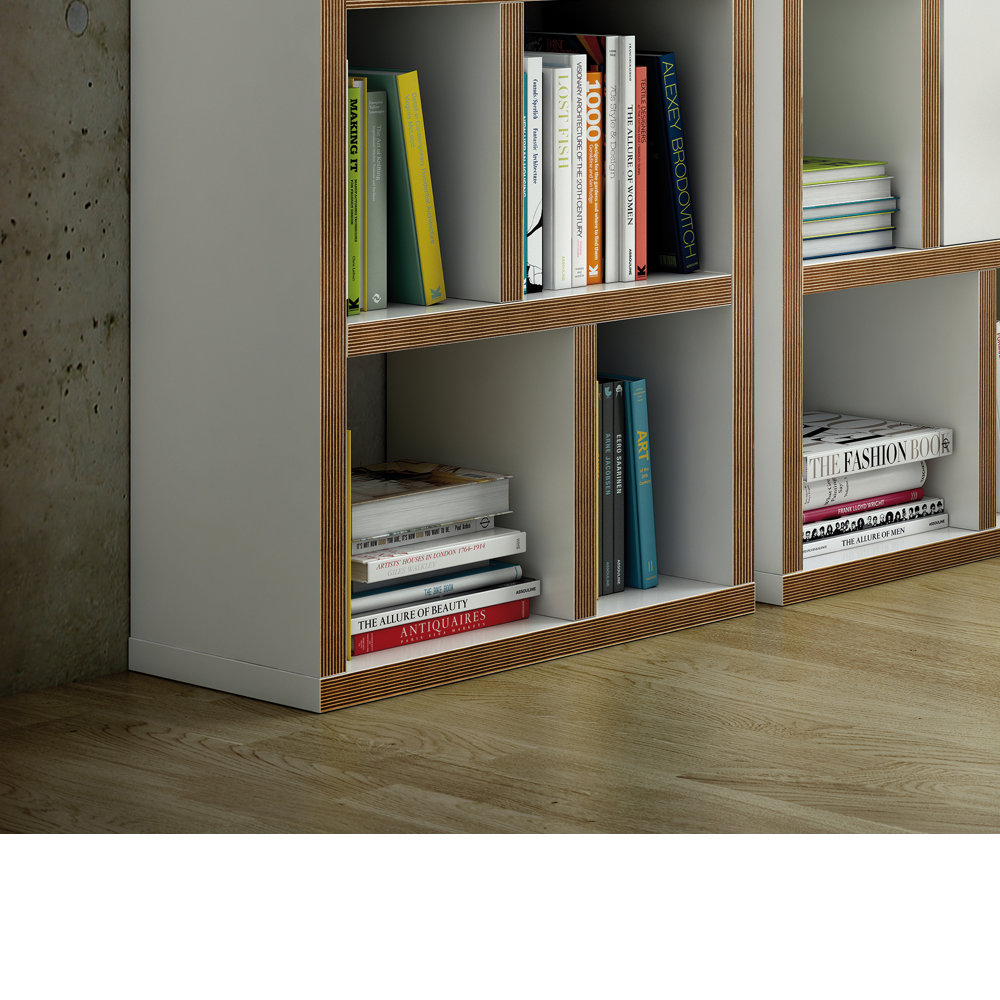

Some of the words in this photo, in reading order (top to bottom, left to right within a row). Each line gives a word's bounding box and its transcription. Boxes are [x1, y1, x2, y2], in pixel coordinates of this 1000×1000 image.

[411, 93, 419, 111] Detail
[558, 75, 569, 124] LOST
[586, 80, 601, 142] 1000
[350, 99, 358, 155] MAKING
[404, 94, 412, 120] Virginia
[408, 122, 416, 148] McLeod
[609, 103, 617, 129] Style
[415, 120, 426, 167] Contemporary
[558, 128, 569, 168] FISH
[610, 131, 617, 139] &
[350, 159, 358, 173] IT
[576, 152, 583, 162] OF
[609, 142, 617, 179] Design
[662, 61, 682, 131] ALEXEY
[672, 137, 697, 258] BRODOVITCH
[421, 168, 432, 205] Residential
[627, 170, 634, 184] OF
[426, 206, 435, 244] Architecture
[637, 430, 649, 461] ART
[809, 453, 841, 479] THE
[844, 440, 907, 472] FASHION
[910, 432, 951, 460] BOOK
[838, 507, 853, 515] FRANK
[853, 503, 867, 513] LLOYD
[867, 500, 885, 510] WRIGHT
[841, 538, 856, 547] THE
[856, 534, 881, 545] ALLURE
[881, 531, 890, 539] OF
[891, 527, 906, 537] MEN
[376, 559, 402, 571] ARTISTS'
[402, 555, 425, 566] HOUSES
[425, 553, 433, 561] IN
[433, 549, 457, 559] LONDON
[424, 588, 432, 596] THE
[444, 583, 454, 593] BOOK
[358, 618, 378, 631] THE
[379, 611, 416, 626] ALLURE
[417, 607, 431, 617] OF
[431, 599, 468, 615] BEAUTY
[400, 609, 487, 638] ANTIQUAIRES
